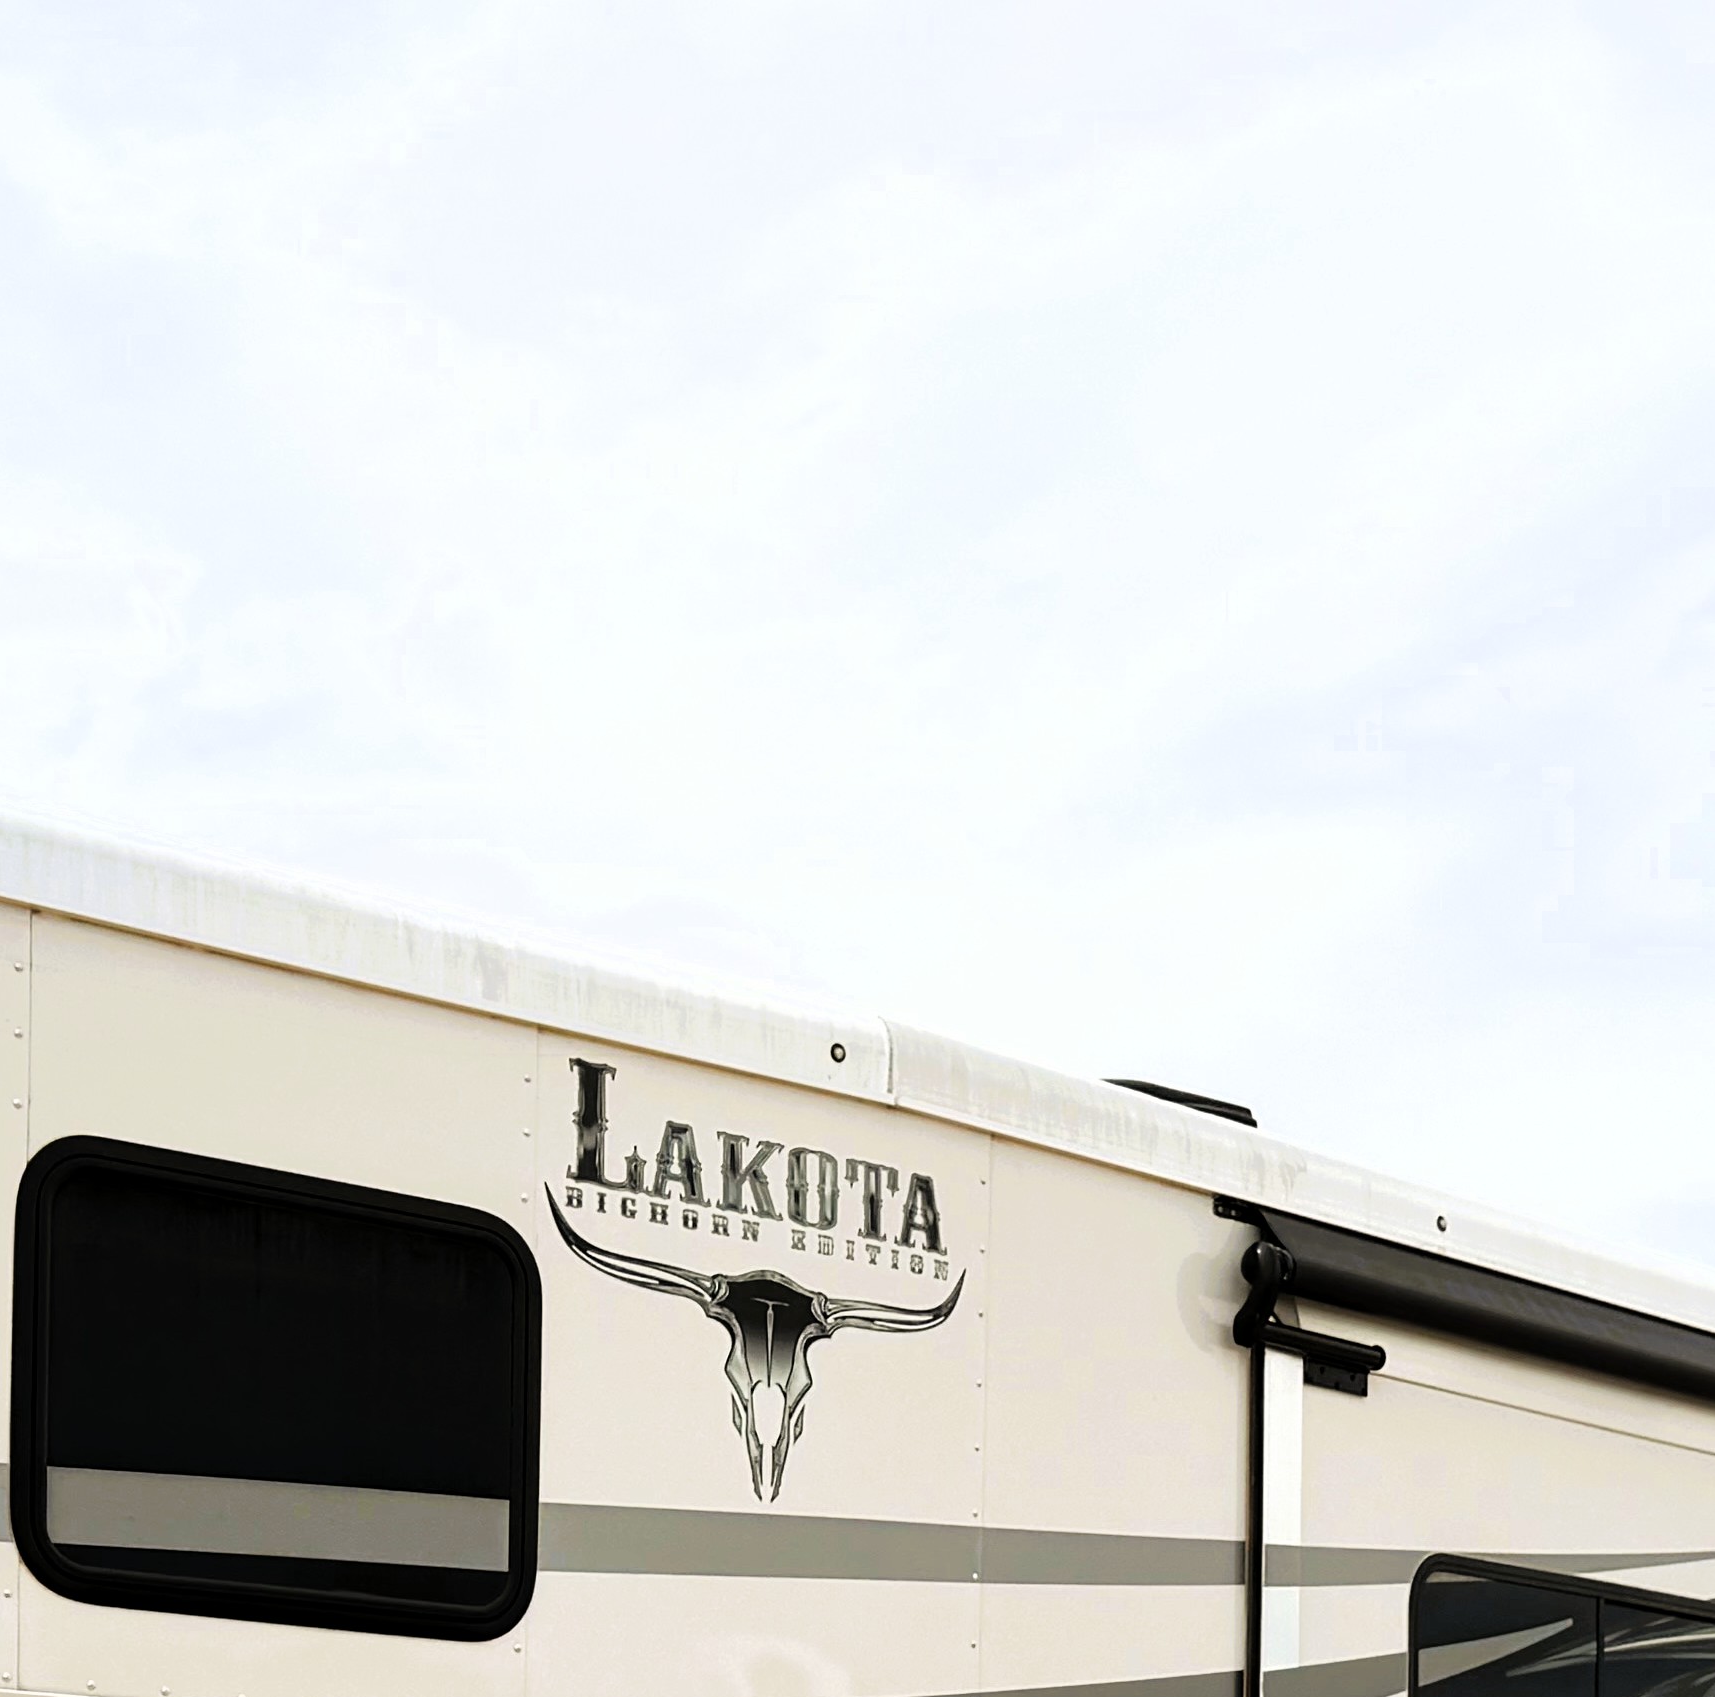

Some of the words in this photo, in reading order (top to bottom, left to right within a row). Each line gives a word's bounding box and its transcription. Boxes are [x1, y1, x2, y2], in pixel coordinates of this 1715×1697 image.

[566, 1057, 948, 1256] LAKOTA
[565, 1185, 761, 1243] BIGHORN
[790, 1229, 950, 1282] EDITION
